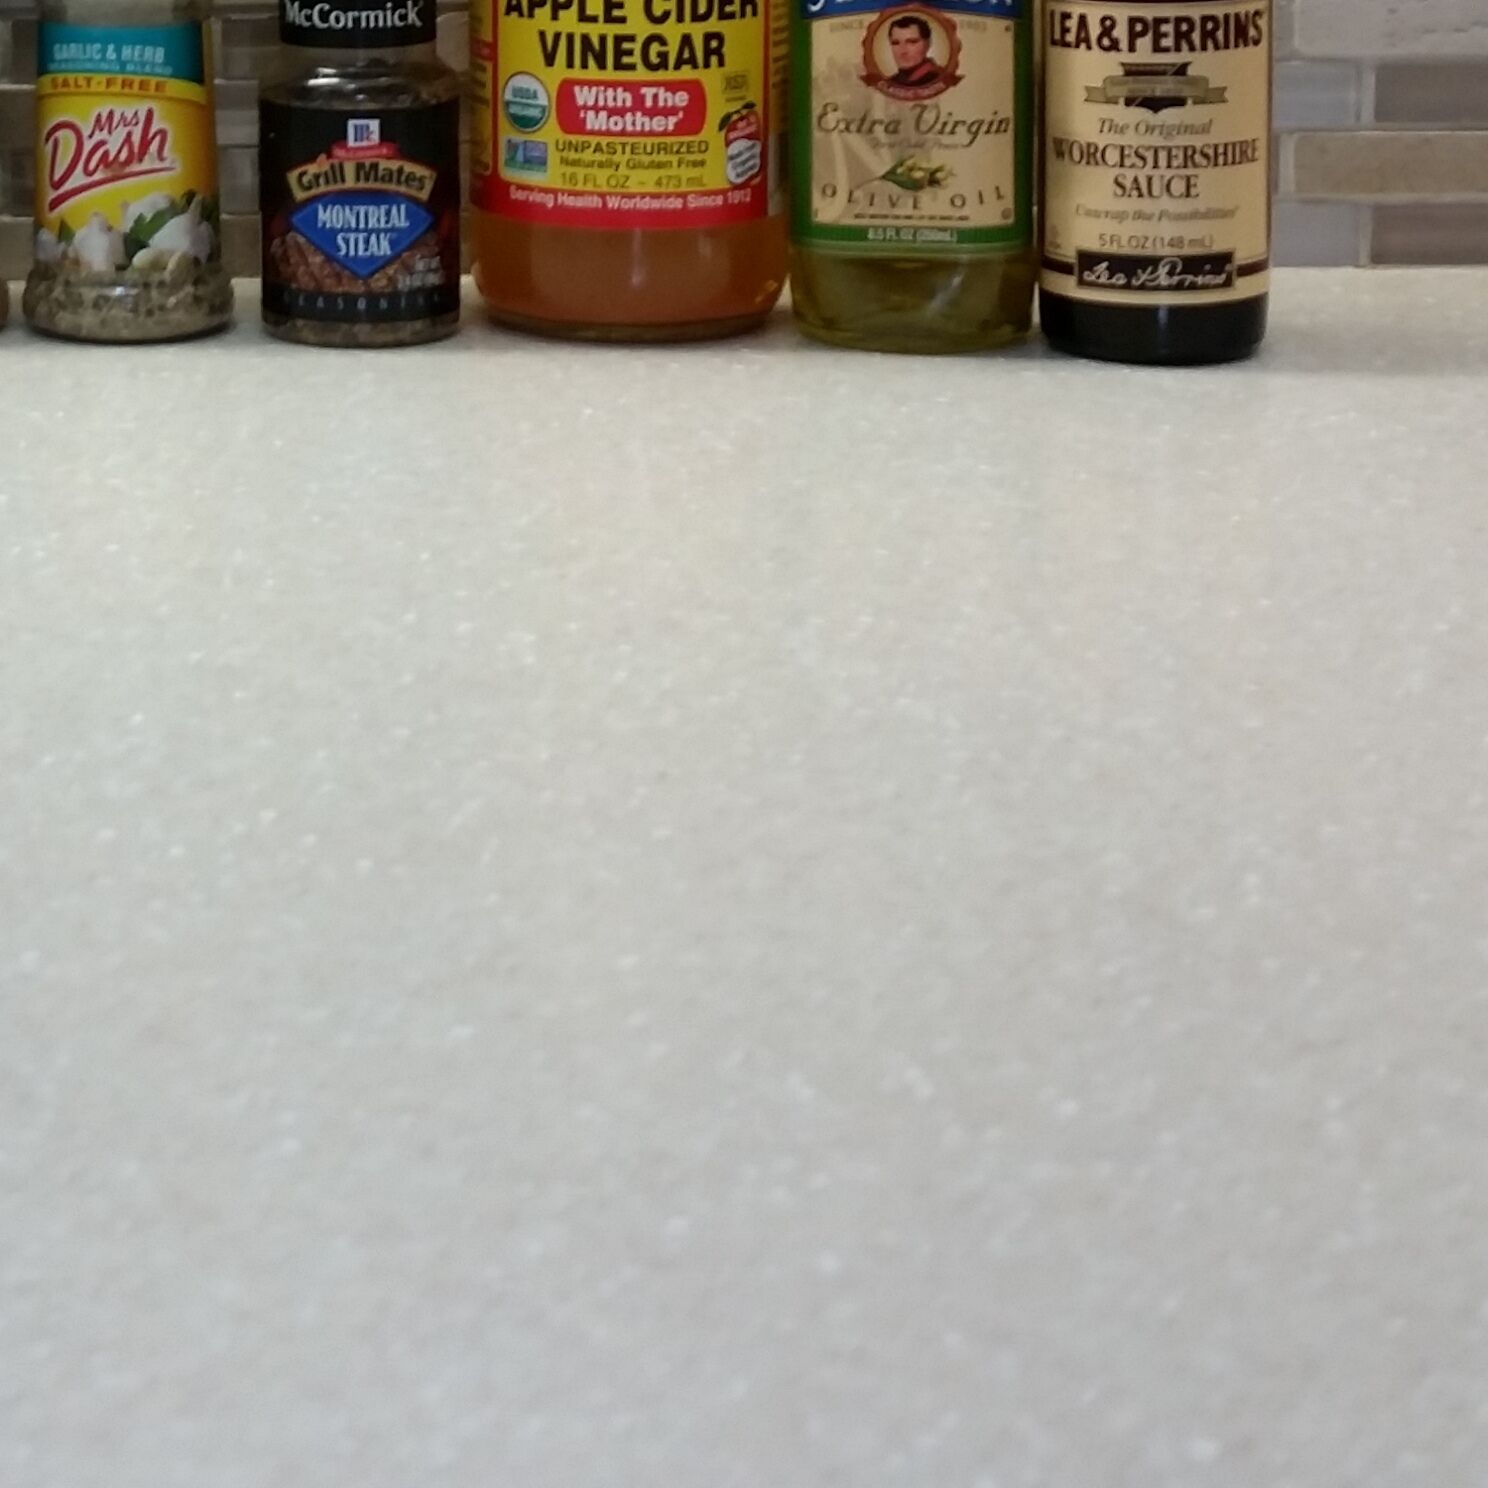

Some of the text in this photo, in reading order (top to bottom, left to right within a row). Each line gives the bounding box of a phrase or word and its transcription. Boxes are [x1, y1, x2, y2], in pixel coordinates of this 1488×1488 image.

[53, 42, 102, 61] GARLIC
[121, 44, 165, 64] HERB
[538, 30, 726, 71] VINEGAR
[574, 86, 689, 108] With The
[816, 101, 1012, 148] Extra Virgin
[1098, 117, 1213, 140] The Original
[44, 107, 168, 191] Dash
[556, 139, 709, 156] UNPASTEURIZED
[1052, 136, 1261, 170] WORCESTERSHIRE
[560, 156, 621, 171] Naturally
[677, 156, 707, 169] Free
[297, 161, 428, 193] Grill Mates
[1112, 173, 1200, 200] SAUCE
[510, 188, 554, 208] Serving
[558, 192, 602, 209] Health
[606, 193, 683, 211] Worldwide
[686, 191, 723, 209] Since
[316, 204, 410, 229] MONTREAL
[336, 231, 392, 257] STEAK
